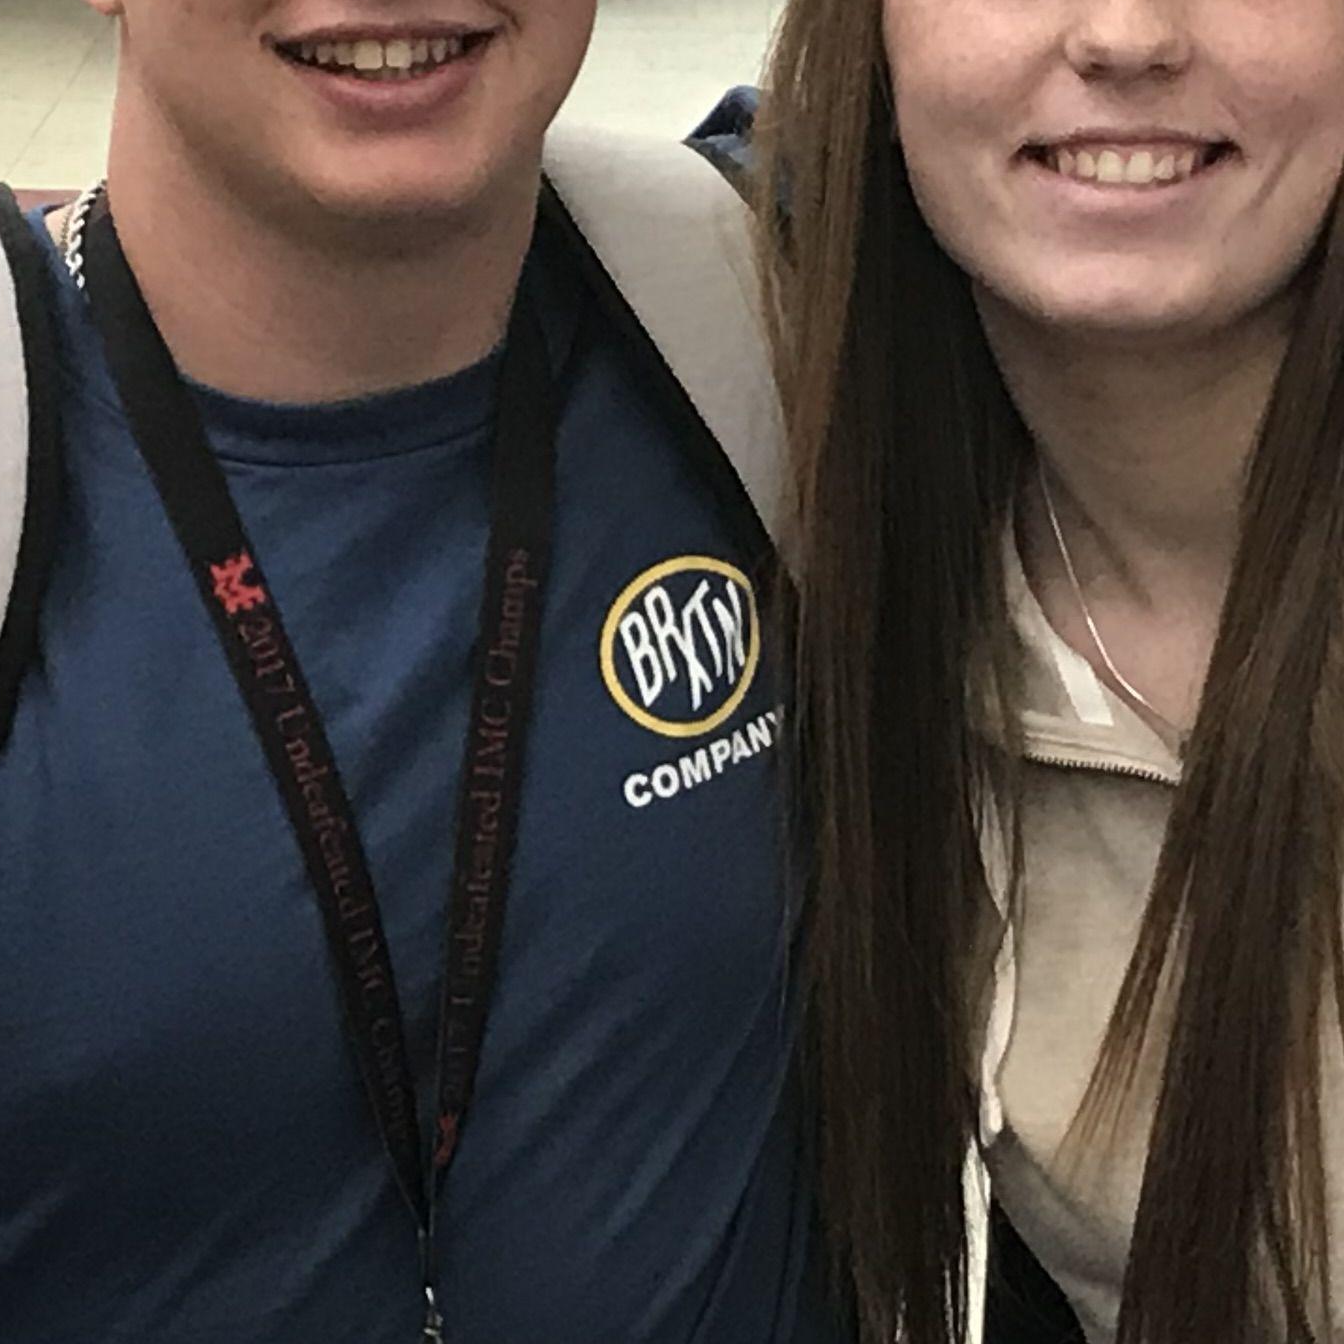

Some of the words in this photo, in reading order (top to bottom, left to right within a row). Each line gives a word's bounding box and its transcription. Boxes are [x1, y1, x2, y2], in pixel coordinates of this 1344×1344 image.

[237, 616, 297, 694] 2017
[484, 547, 539, 686] Champs
[473, 699, 511, 778] IMC
